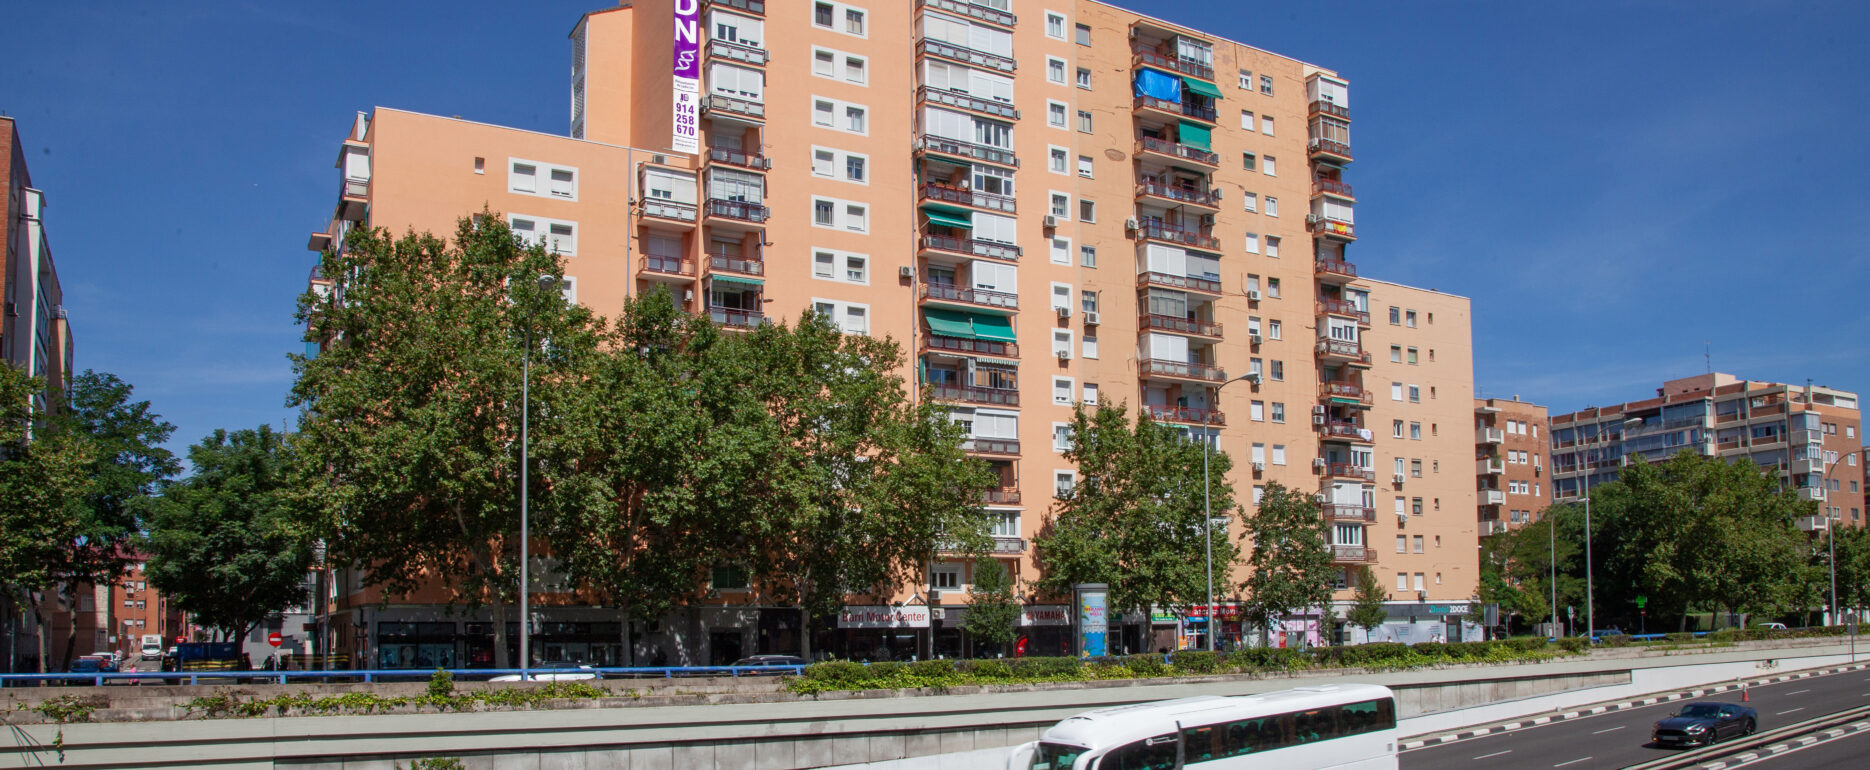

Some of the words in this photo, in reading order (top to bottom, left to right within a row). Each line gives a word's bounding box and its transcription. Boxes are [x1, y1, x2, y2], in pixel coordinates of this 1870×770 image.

[676, 103, 694, 114] 914
[676, 113, 694, 125] 258
[676, 124, 694, 136] 670
[1449, 605, 1468, 613] 2DOCE
[867, 611, 894, 623] Motor
[896, 611, 926, 622] Center
[1035, 610, 1065, 620] YAMAHA
